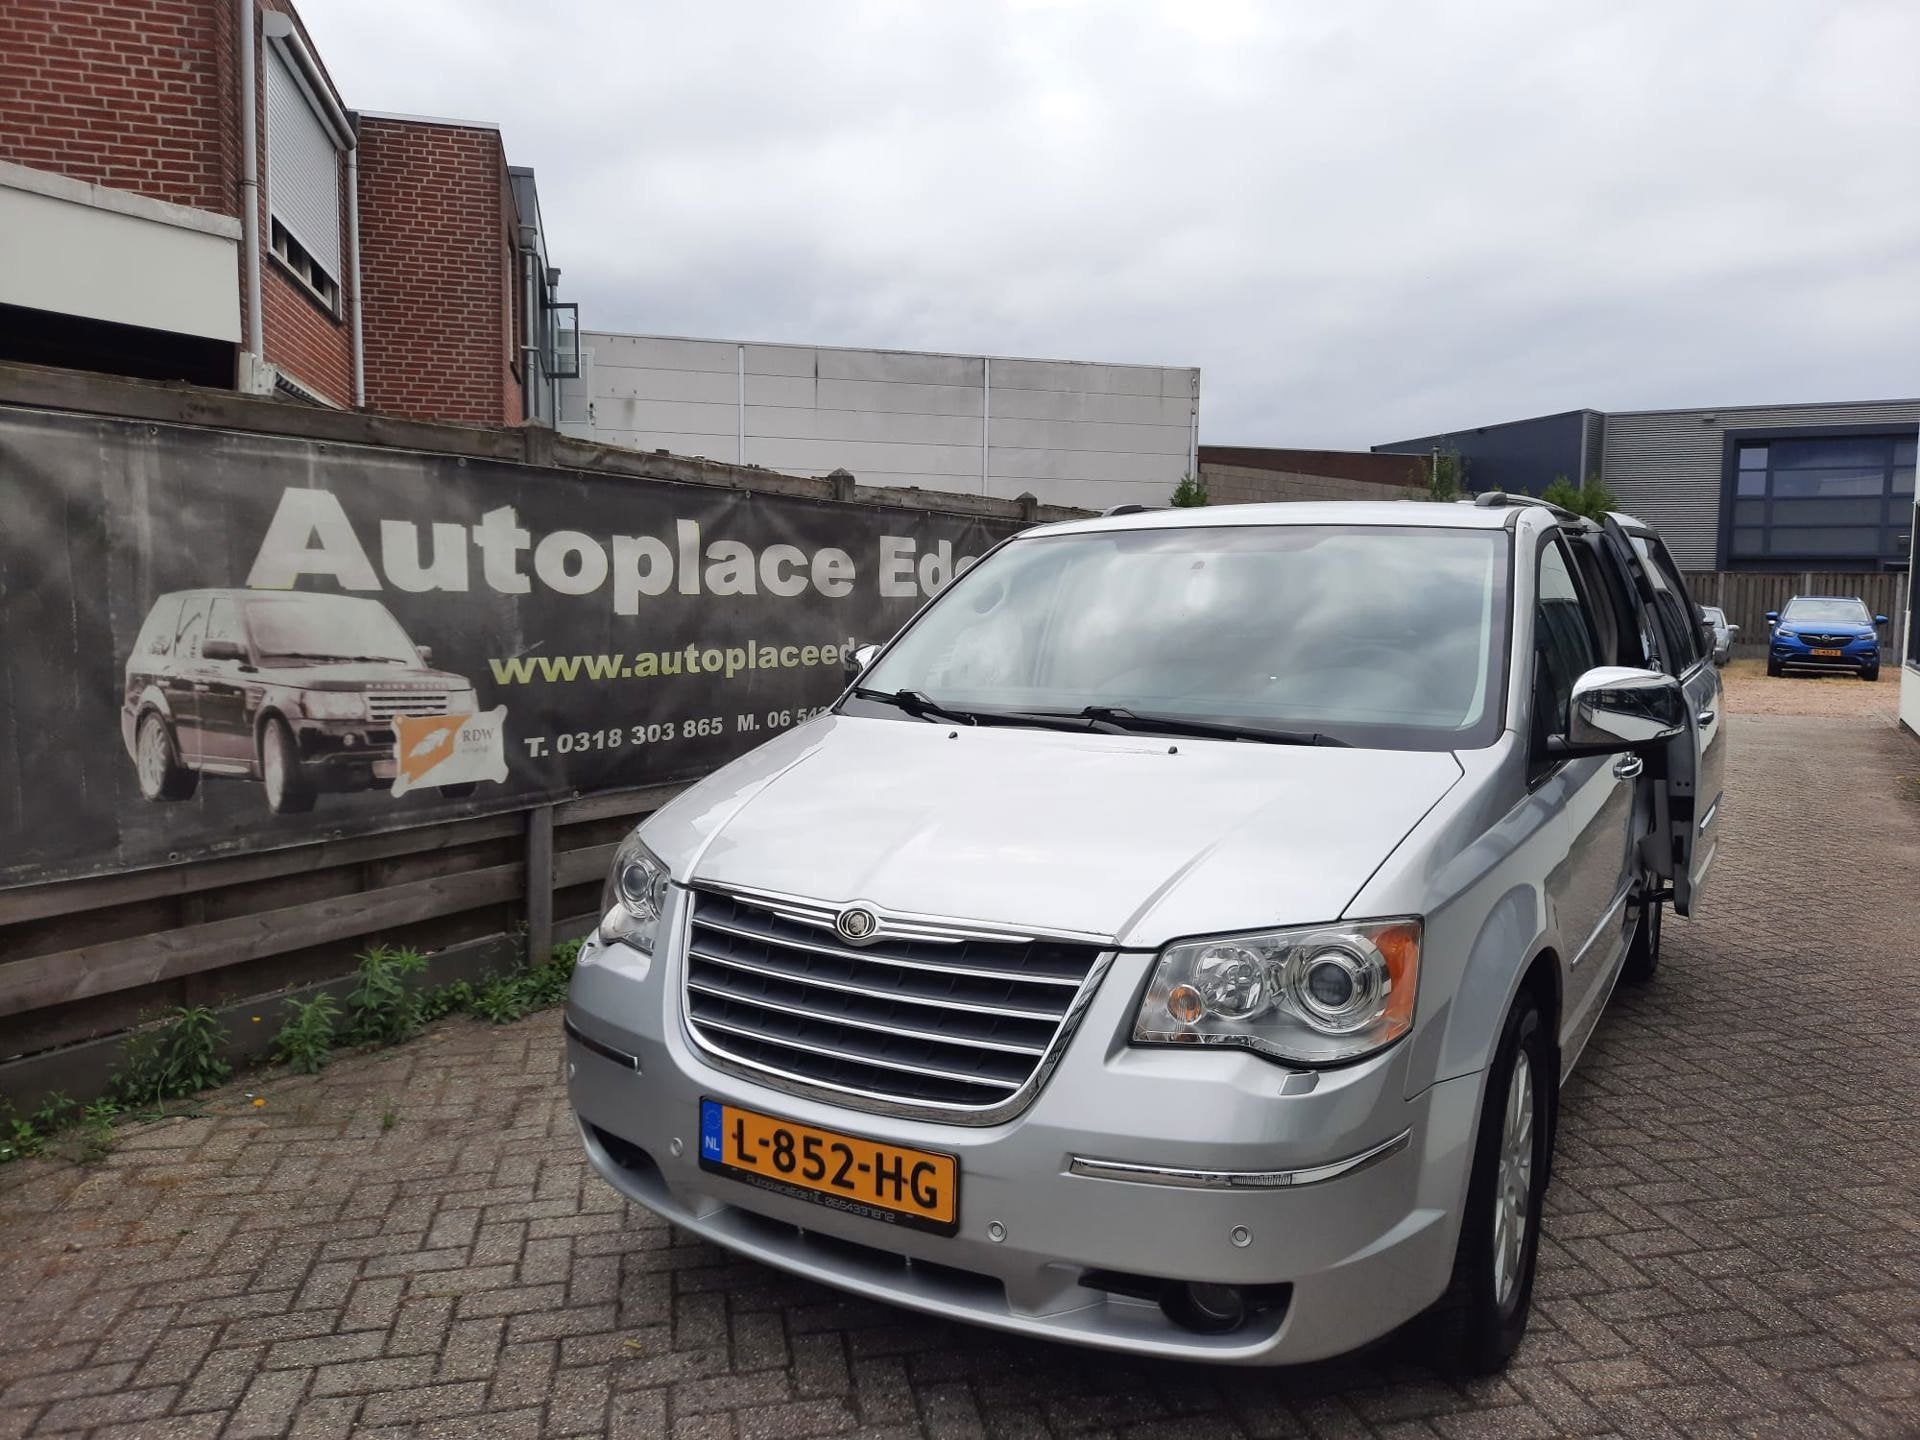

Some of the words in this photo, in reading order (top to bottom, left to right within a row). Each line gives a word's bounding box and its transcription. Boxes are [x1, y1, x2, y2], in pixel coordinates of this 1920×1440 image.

[245, 487, 855, 615] Autoplace
[488, 637, 870, 684] www.autoplaceed
[462, 727, 494, 742] RDW
[524, 737, 548, 757] T.
[556, 728, 622, 754] 0318
[631, 722, 675, 745] 303
[683, 717, 723, 739] 865
[737, 713, 760, 732] M.
[767, 710, 791, 729] 06
[705, 1135, 720, 1151] NL
[736, 1118, 938, 1209] L-852-HG
